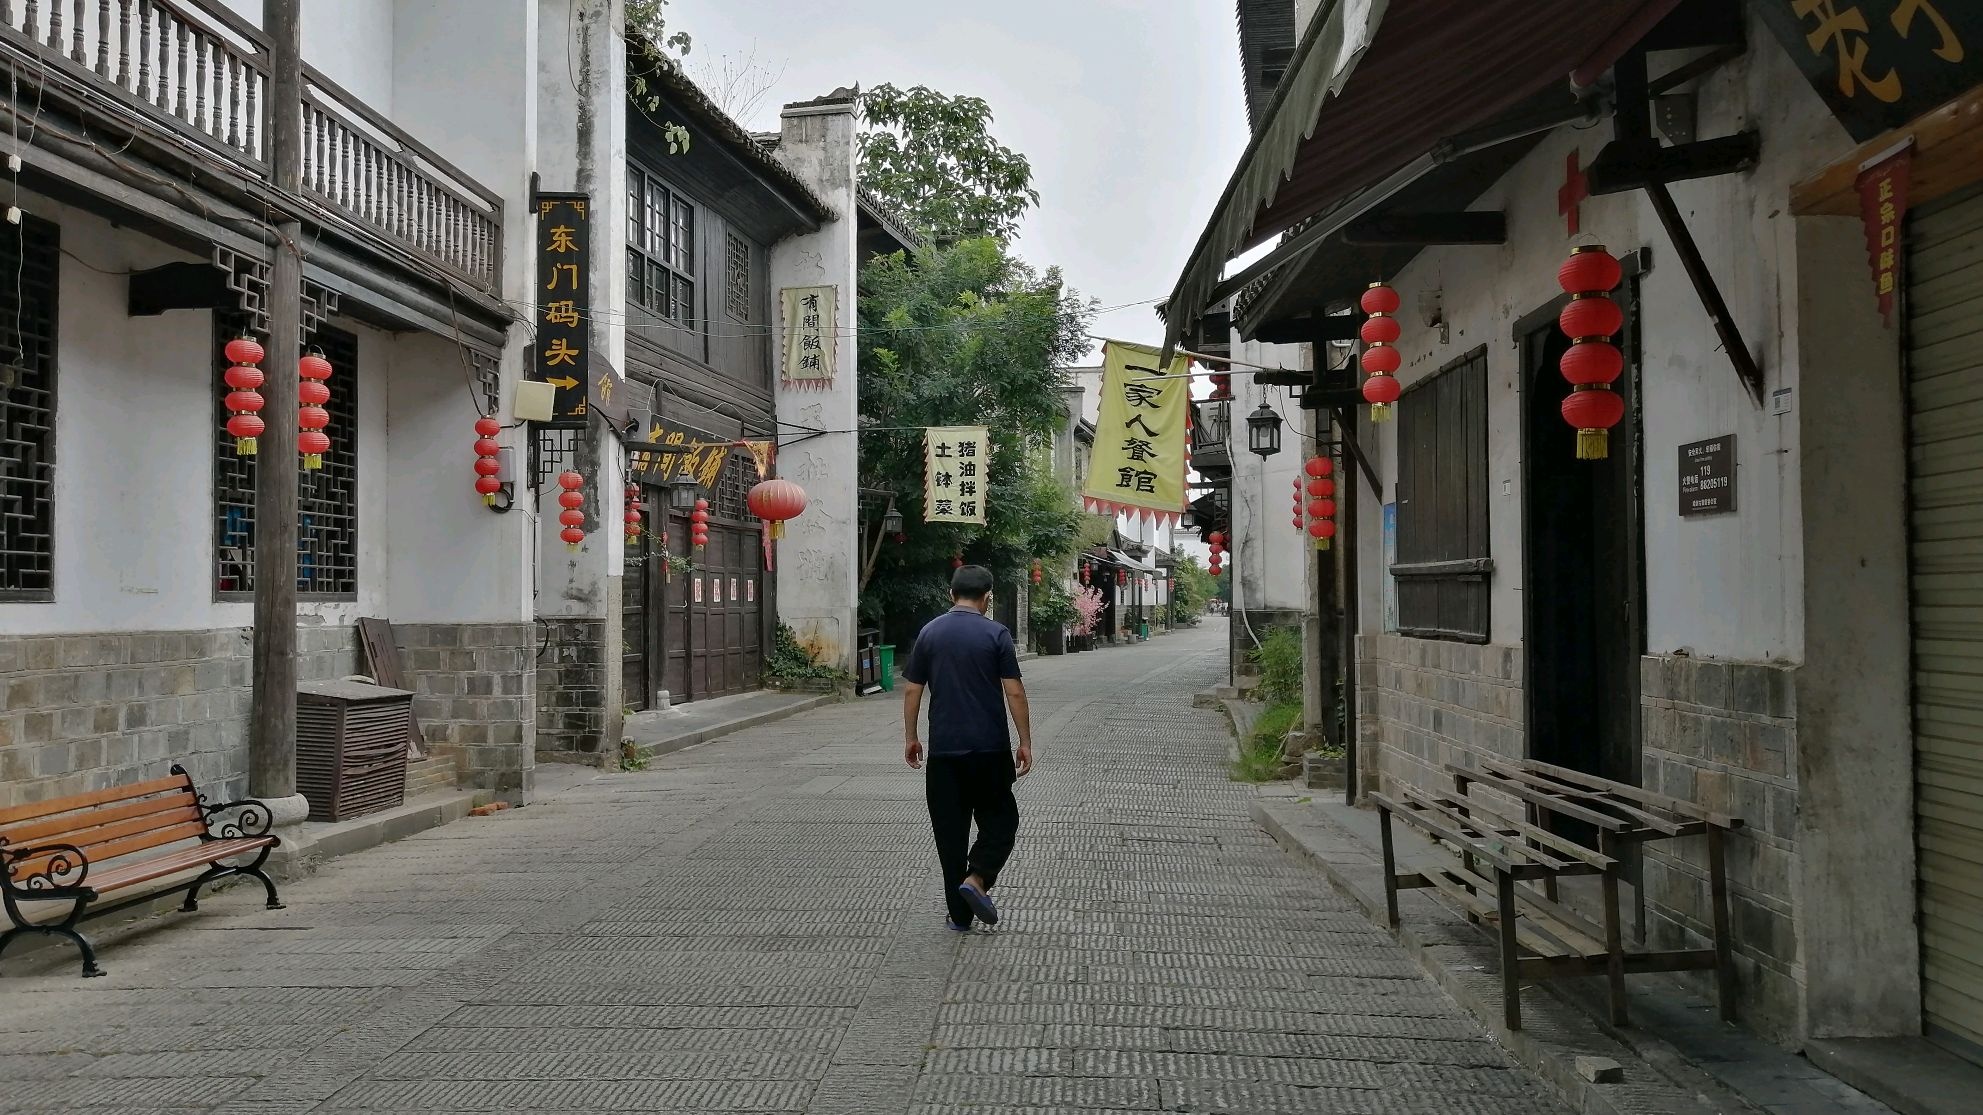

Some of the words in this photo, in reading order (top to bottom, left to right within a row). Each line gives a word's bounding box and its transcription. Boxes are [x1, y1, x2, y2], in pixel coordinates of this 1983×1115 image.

[545, 225, 580, 365] 东门码头
[1116, 364, 1168, 494] 一家人餐館
[935, 442, 953, 515] 土钵菜
[958, 441, 976, 516] 猪油拌饭
[1700, 465, 1711, 476] 119
